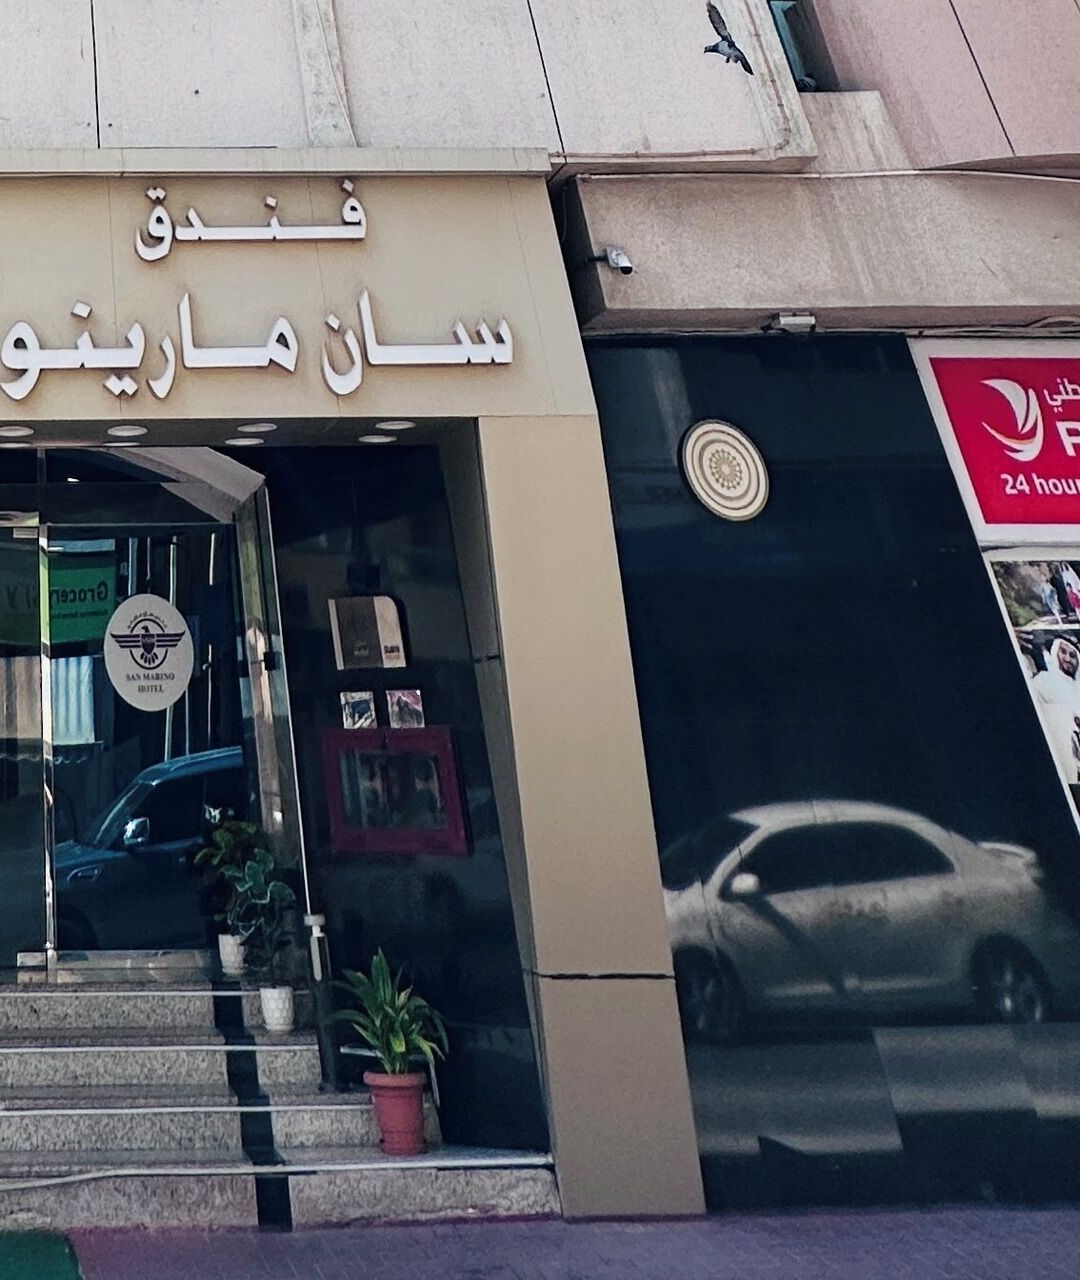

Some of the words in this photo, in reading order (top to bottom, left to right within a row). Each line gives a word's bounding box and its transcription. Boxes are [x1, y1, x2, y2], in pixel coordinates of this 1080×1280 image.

[136, 178, 368, 262] فندق
[322, 287, 514, 397] سان
[1000, 473, 1031, 495] 24
[126, 673, 140, 681] SAN
[143, 672, 175, 681] MARINO
[137, 685, 165, 693] HOTEL
